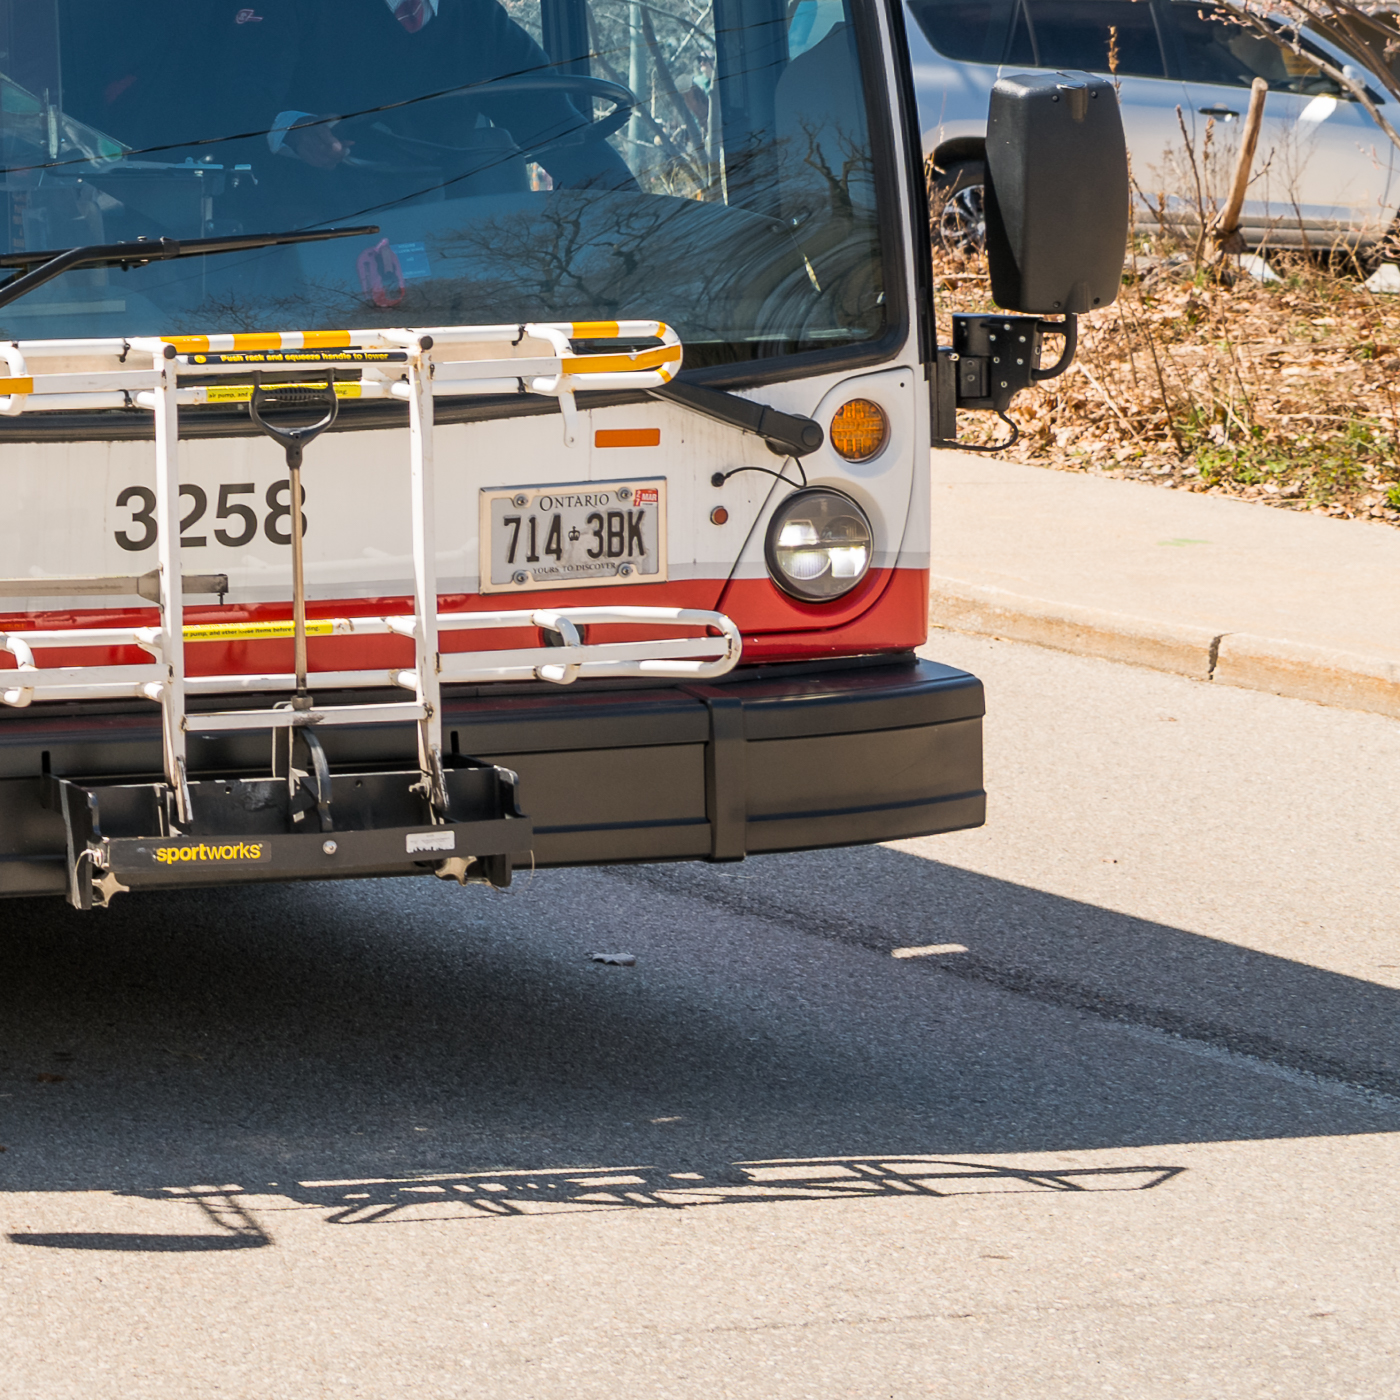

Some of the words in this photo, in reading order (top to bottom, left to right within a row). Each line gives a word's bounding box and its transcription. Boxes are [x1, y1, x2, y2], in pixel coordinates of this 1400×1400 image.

[220, 354, 244, 362] Push
[245, 353, 265, 361] rack
[266, 353, 283, 361] and
[284, 353, 321, 362] squeeze
[321, 352, 352, 360] handle
[364, 352, 389, 360] lower
[539, 493, 610, 512] ONTARIO
[641, 492, 658, 502] MAR
[113, 478, 308, 552] 3258
[503, 512, 563, 564] 714
[586, 508, 646, 560] 3BK
[532, 566, 560, 575] YOURS
[562, 564, 575, 573] TO
[575, 561, 616, 572] DISCOVER
[156, 841, 262, 865] sportworks
